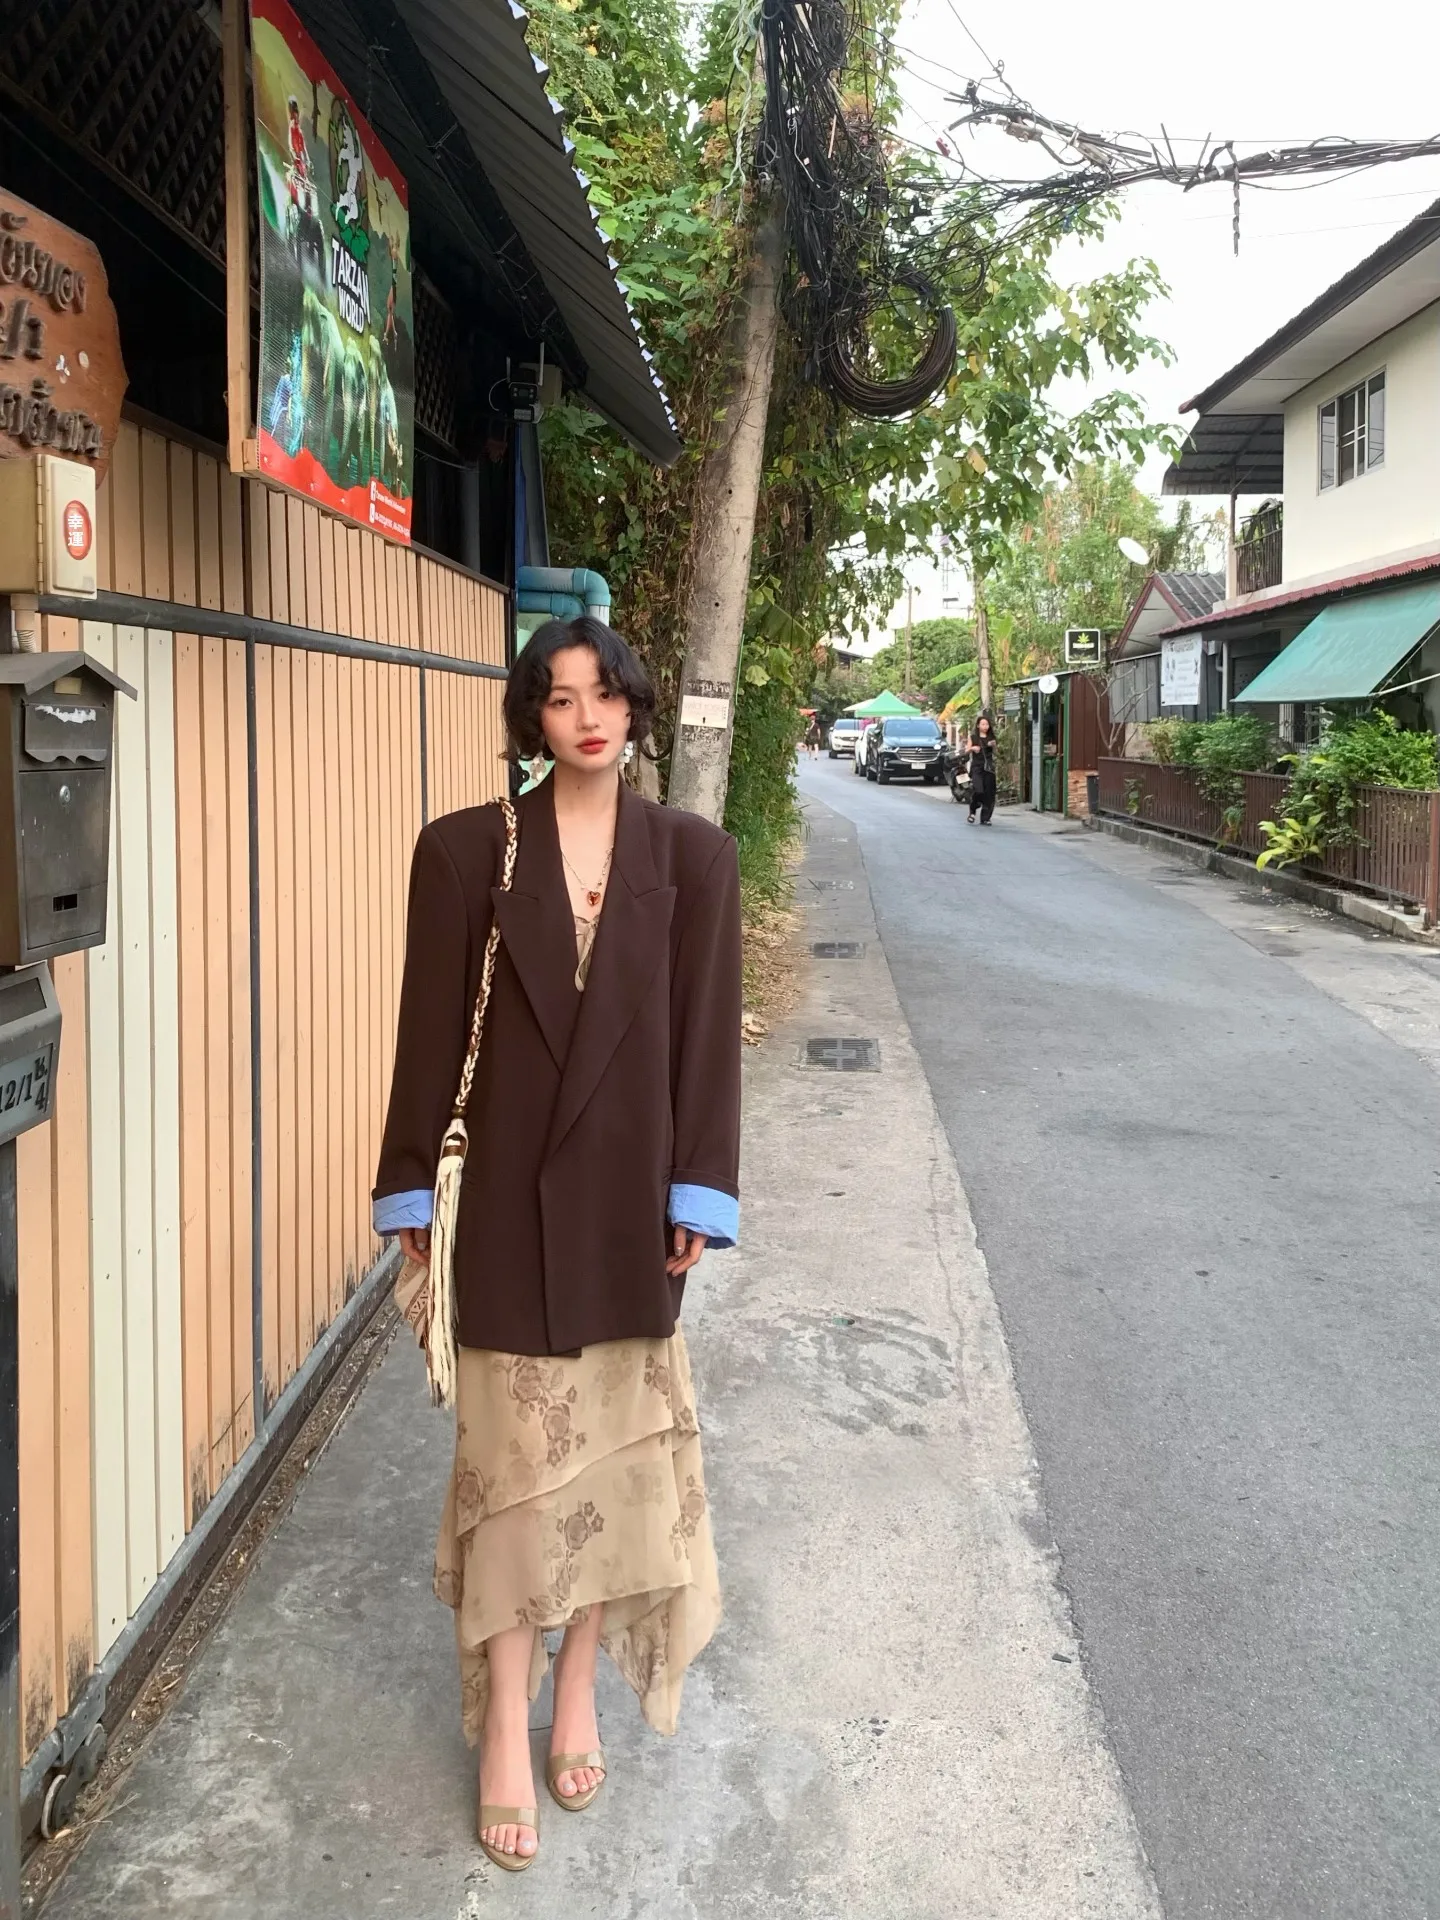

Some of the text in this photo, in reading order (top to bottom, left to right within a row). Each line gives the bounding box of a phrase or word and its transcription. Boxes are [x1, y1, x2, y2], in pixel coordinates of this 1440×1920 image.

[331, 237, 371, 324] TARZAN
[338, 285, 364, 334] WORLD
[67, 512, 85, 547] 幸運
